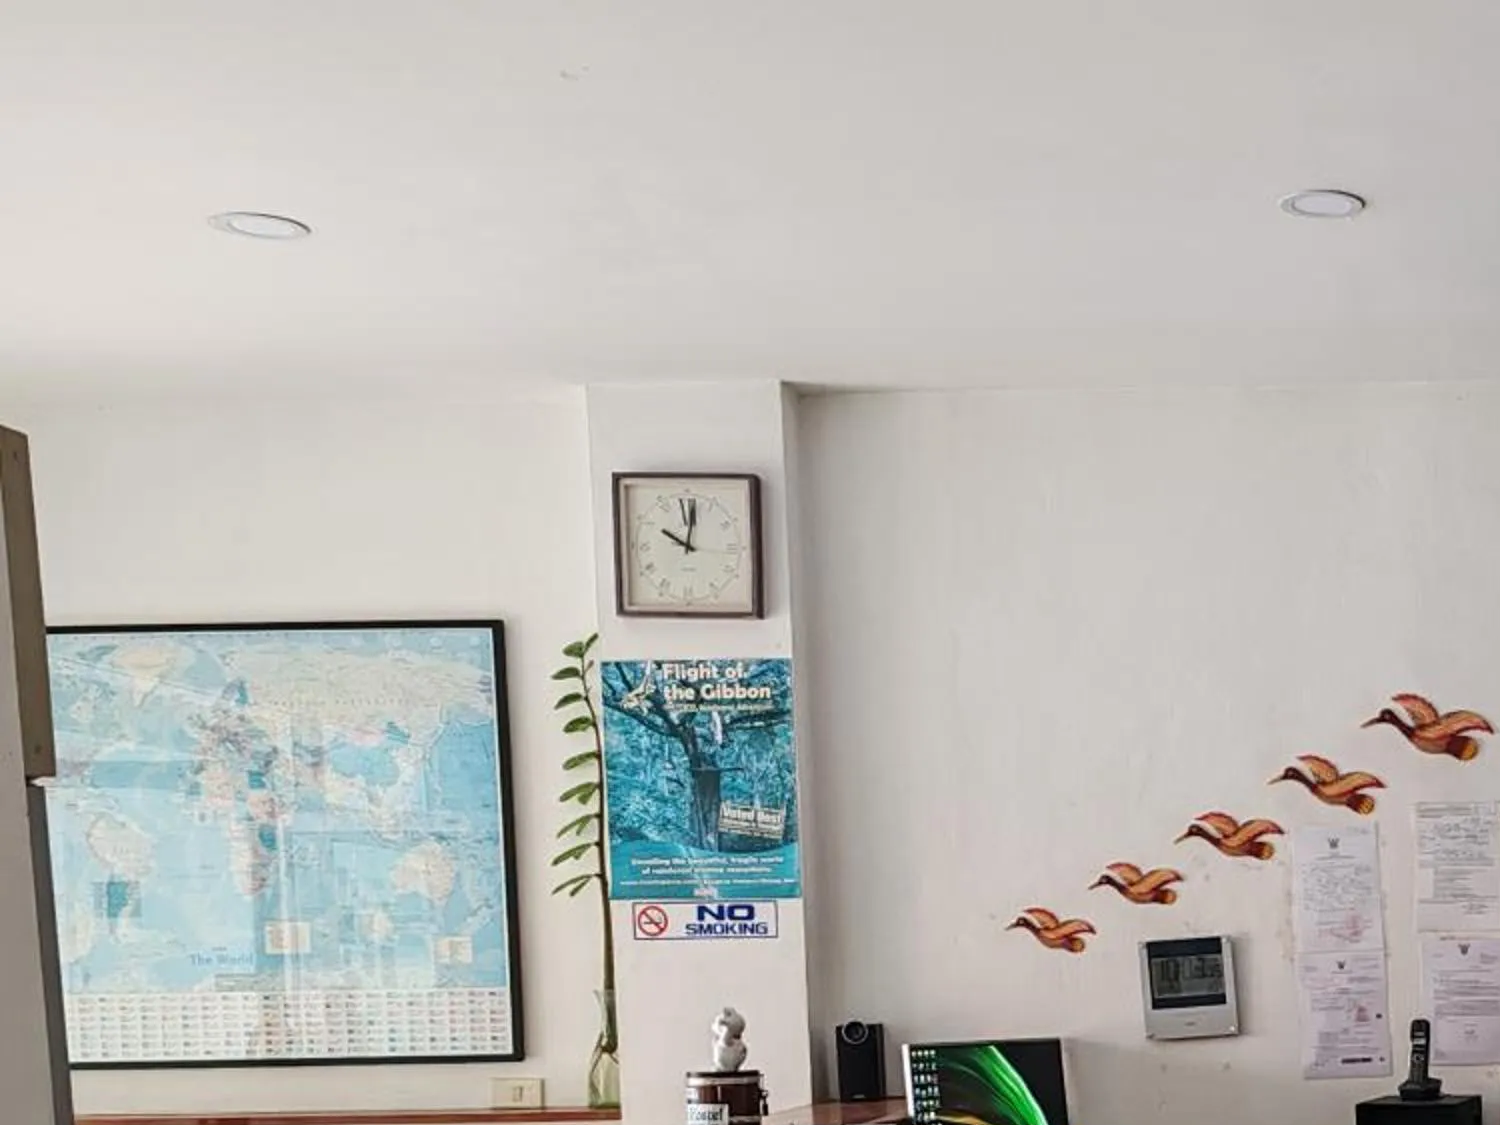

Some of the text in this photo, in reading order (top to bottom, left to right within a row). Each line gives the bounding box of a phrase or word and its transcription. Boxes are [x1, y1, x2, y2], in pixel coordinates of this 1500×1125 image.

[662, 662, 719, 682] Flight
[664, 684, 771, 700] the Gibbon
[697, 904, 755, 921] NO
[686, 922, 768, 935] SMOKING
